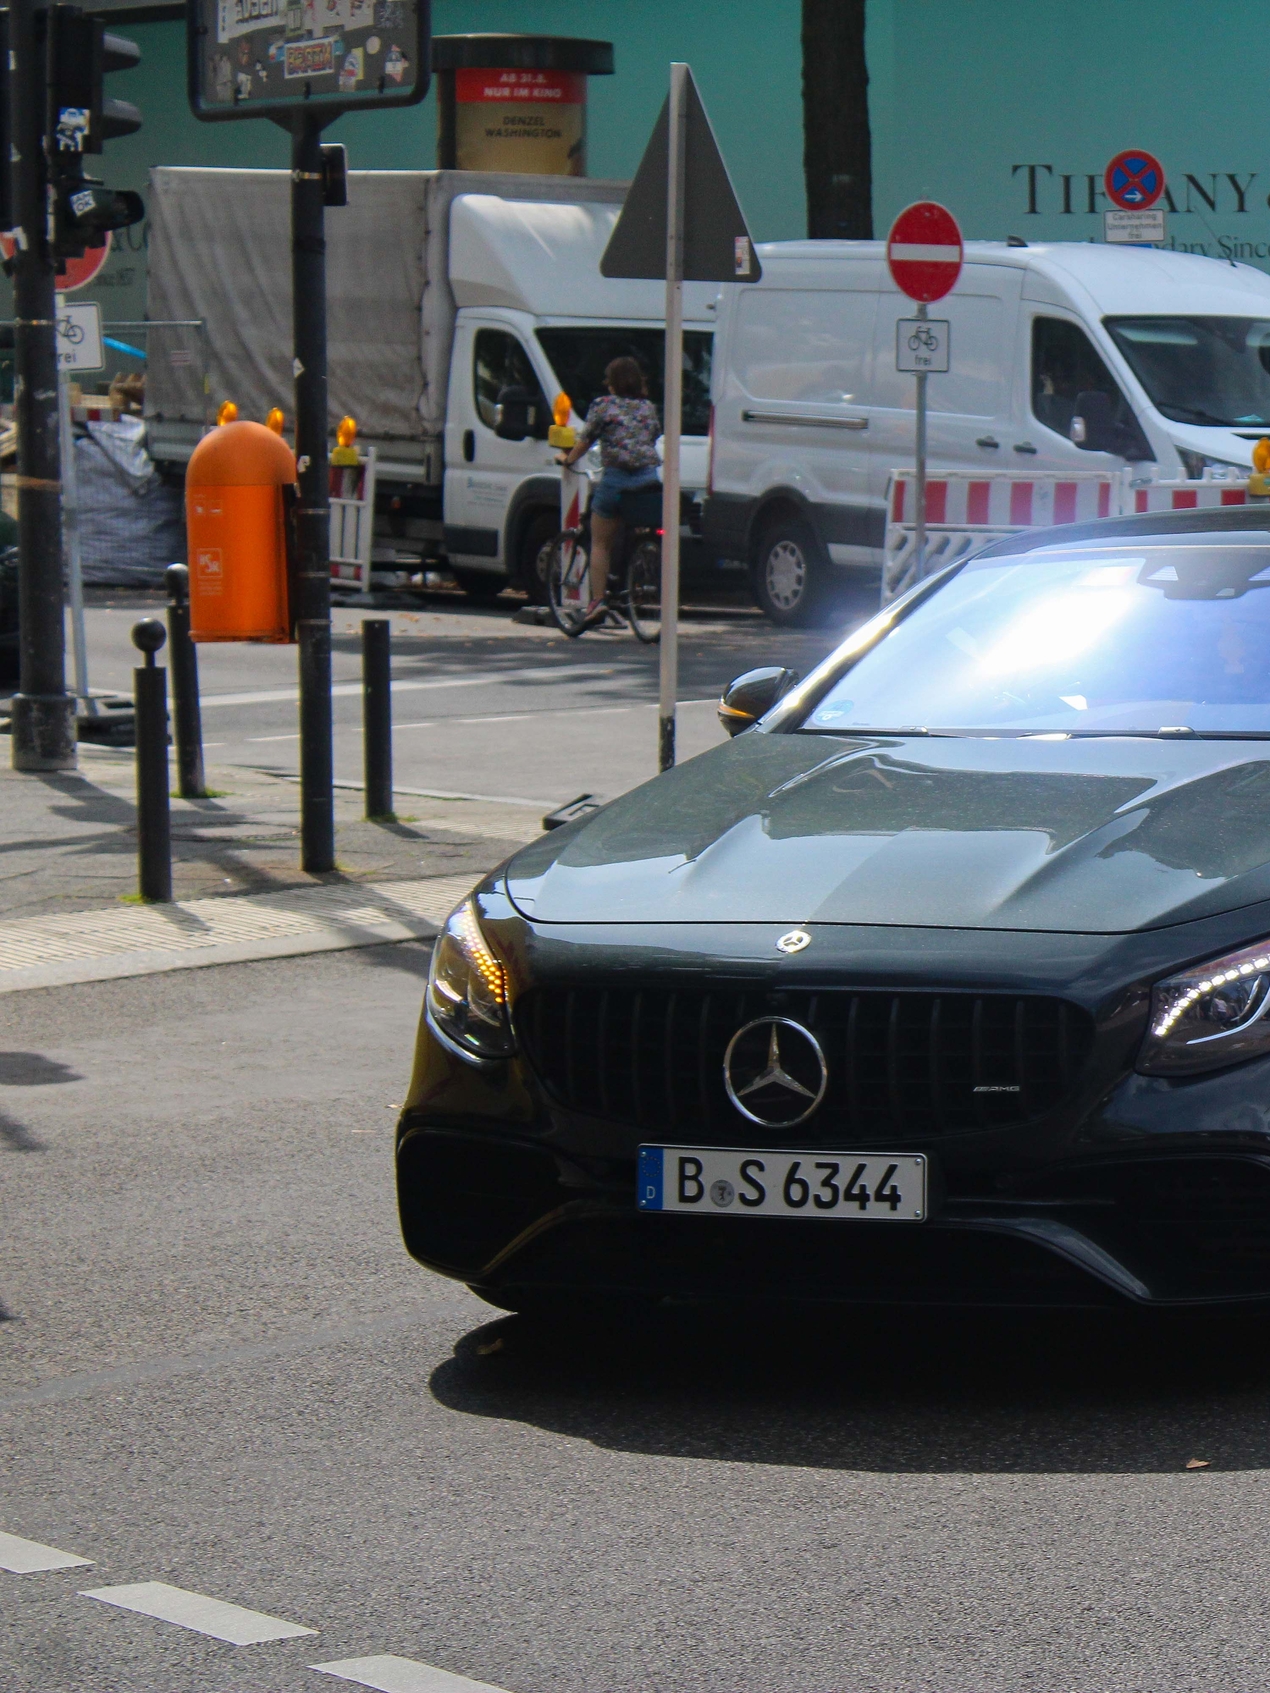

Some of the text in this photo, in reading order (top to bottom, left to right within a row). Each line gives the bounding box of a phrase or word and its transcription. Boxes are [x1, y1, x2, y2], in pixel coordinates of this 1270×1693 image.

[483, 87, 562, 98] NUR IM KINO
[502, 116, 545, 126] DENZEL
[485, 128, 562, 138] WASHINGTON
[1012, 164, 1258, 214] TIFANY
[914, 354, 932, 366] frei
[678, 1156, 902, 1211] B S 6344
[646, 1186, 656, 1199] D
